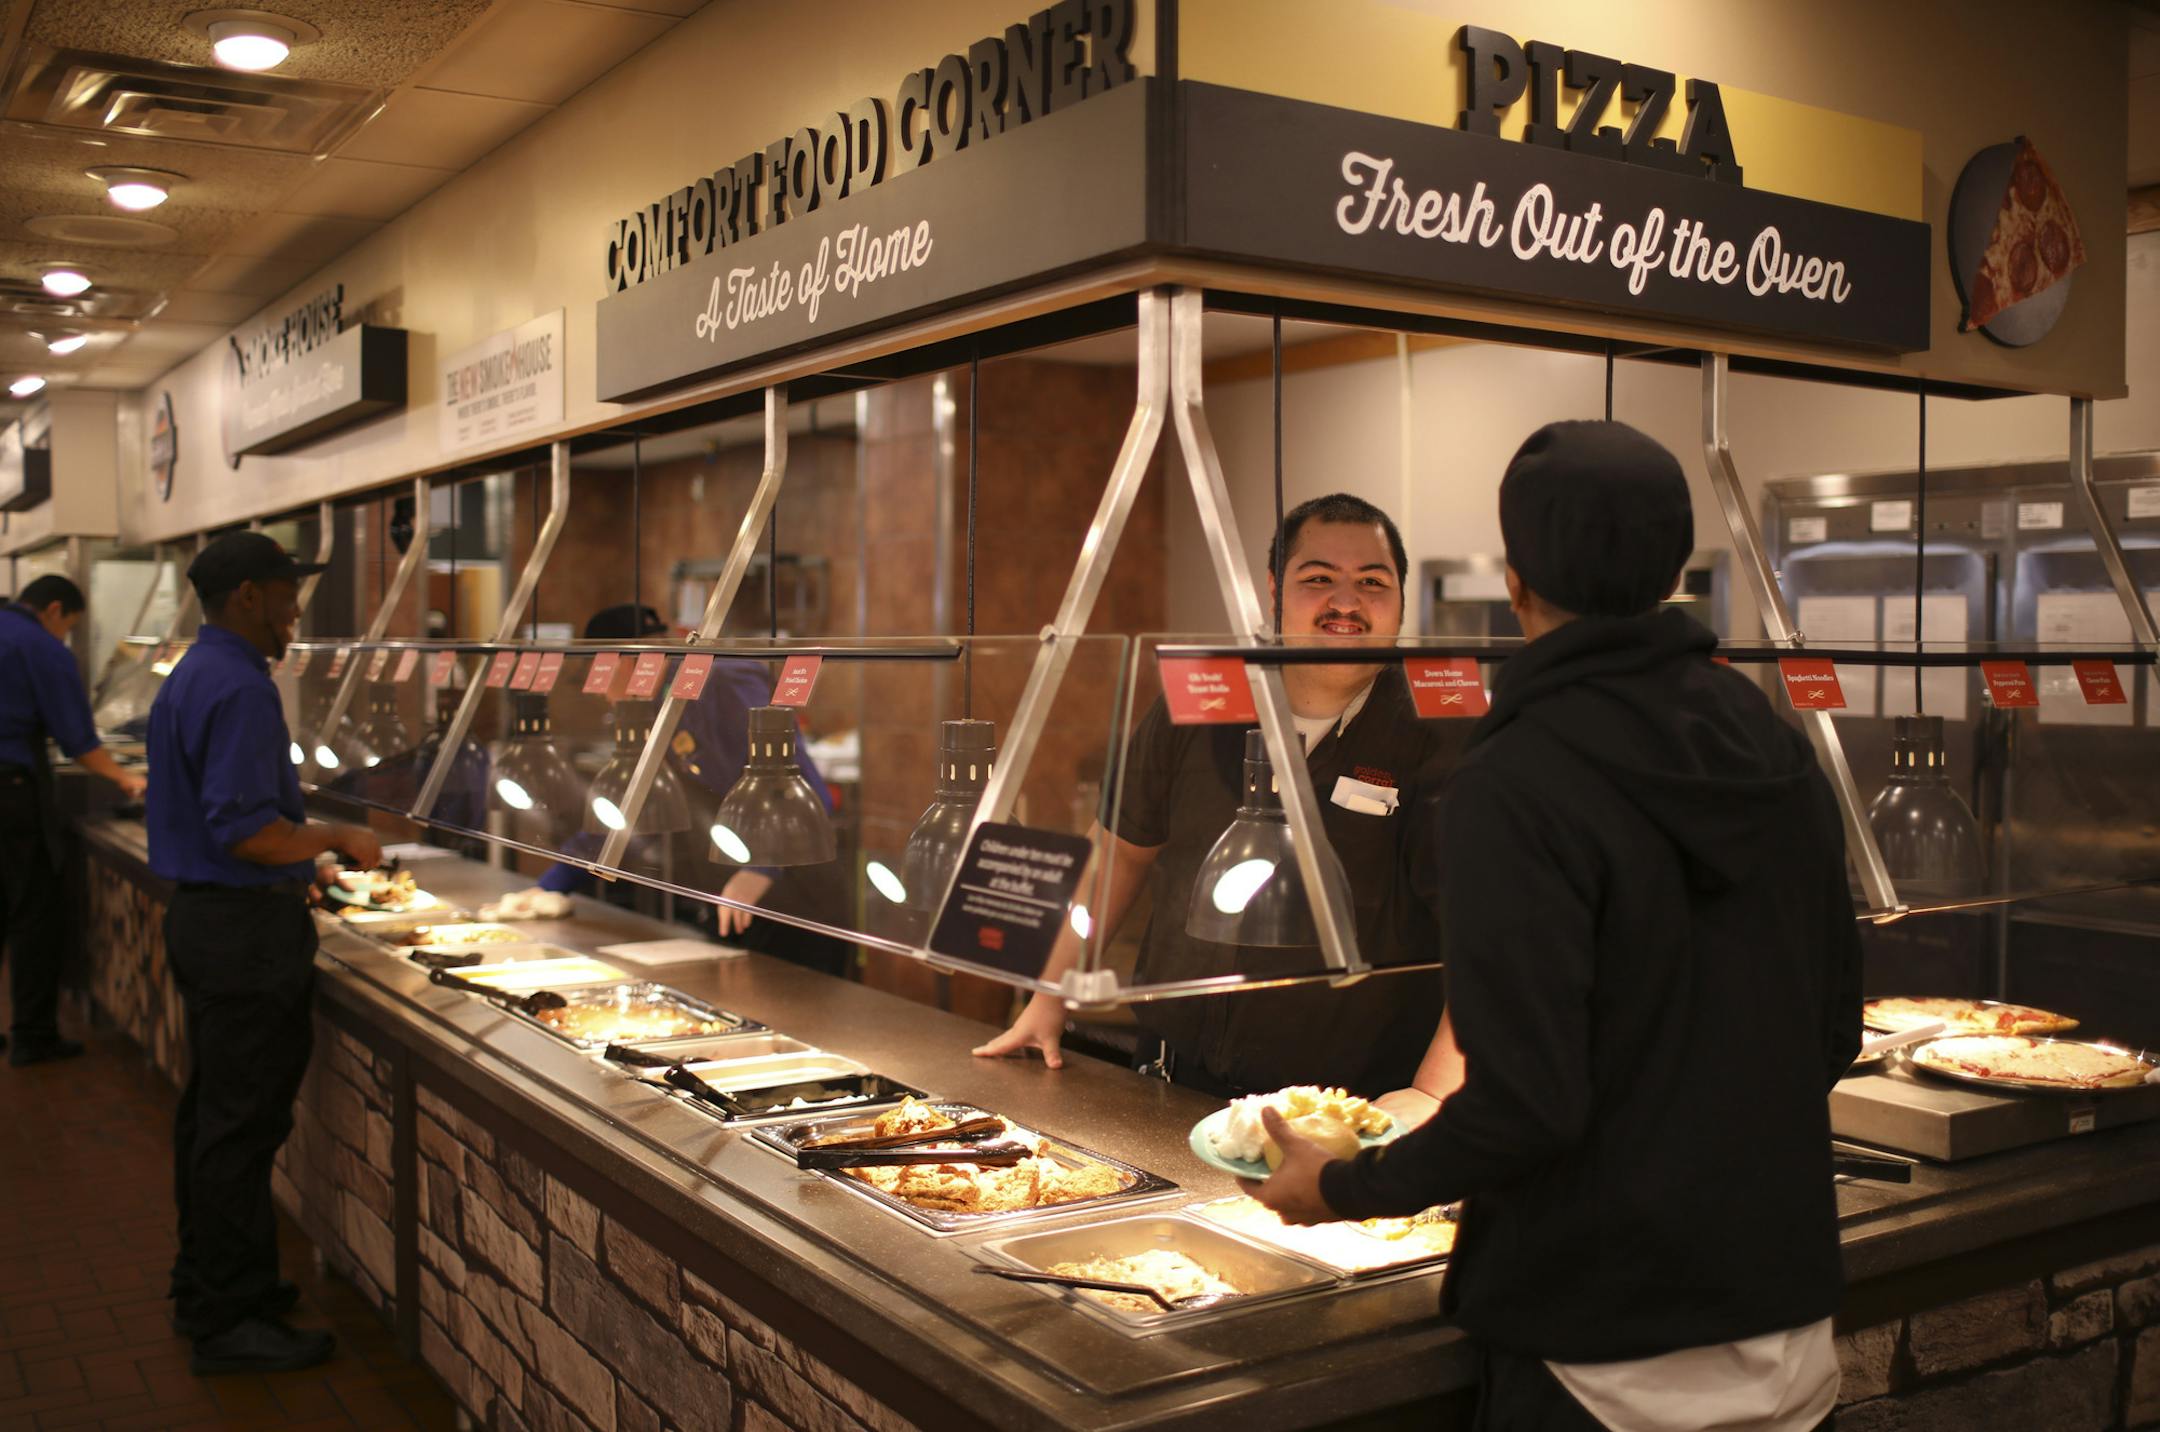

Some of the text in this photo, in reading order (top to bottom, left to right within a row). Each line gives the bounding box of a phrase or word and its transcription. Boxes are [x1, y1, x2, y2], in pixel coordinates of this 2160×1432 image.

[604, 0, 1136, 292] COMFORT FOOD CORNER
[1457, 24, 1744, 188] PIZZA
[696, 220, 933, 342] A Taste of Home
[1335, 151, 1852, 304] Fresh Out of the Oven
